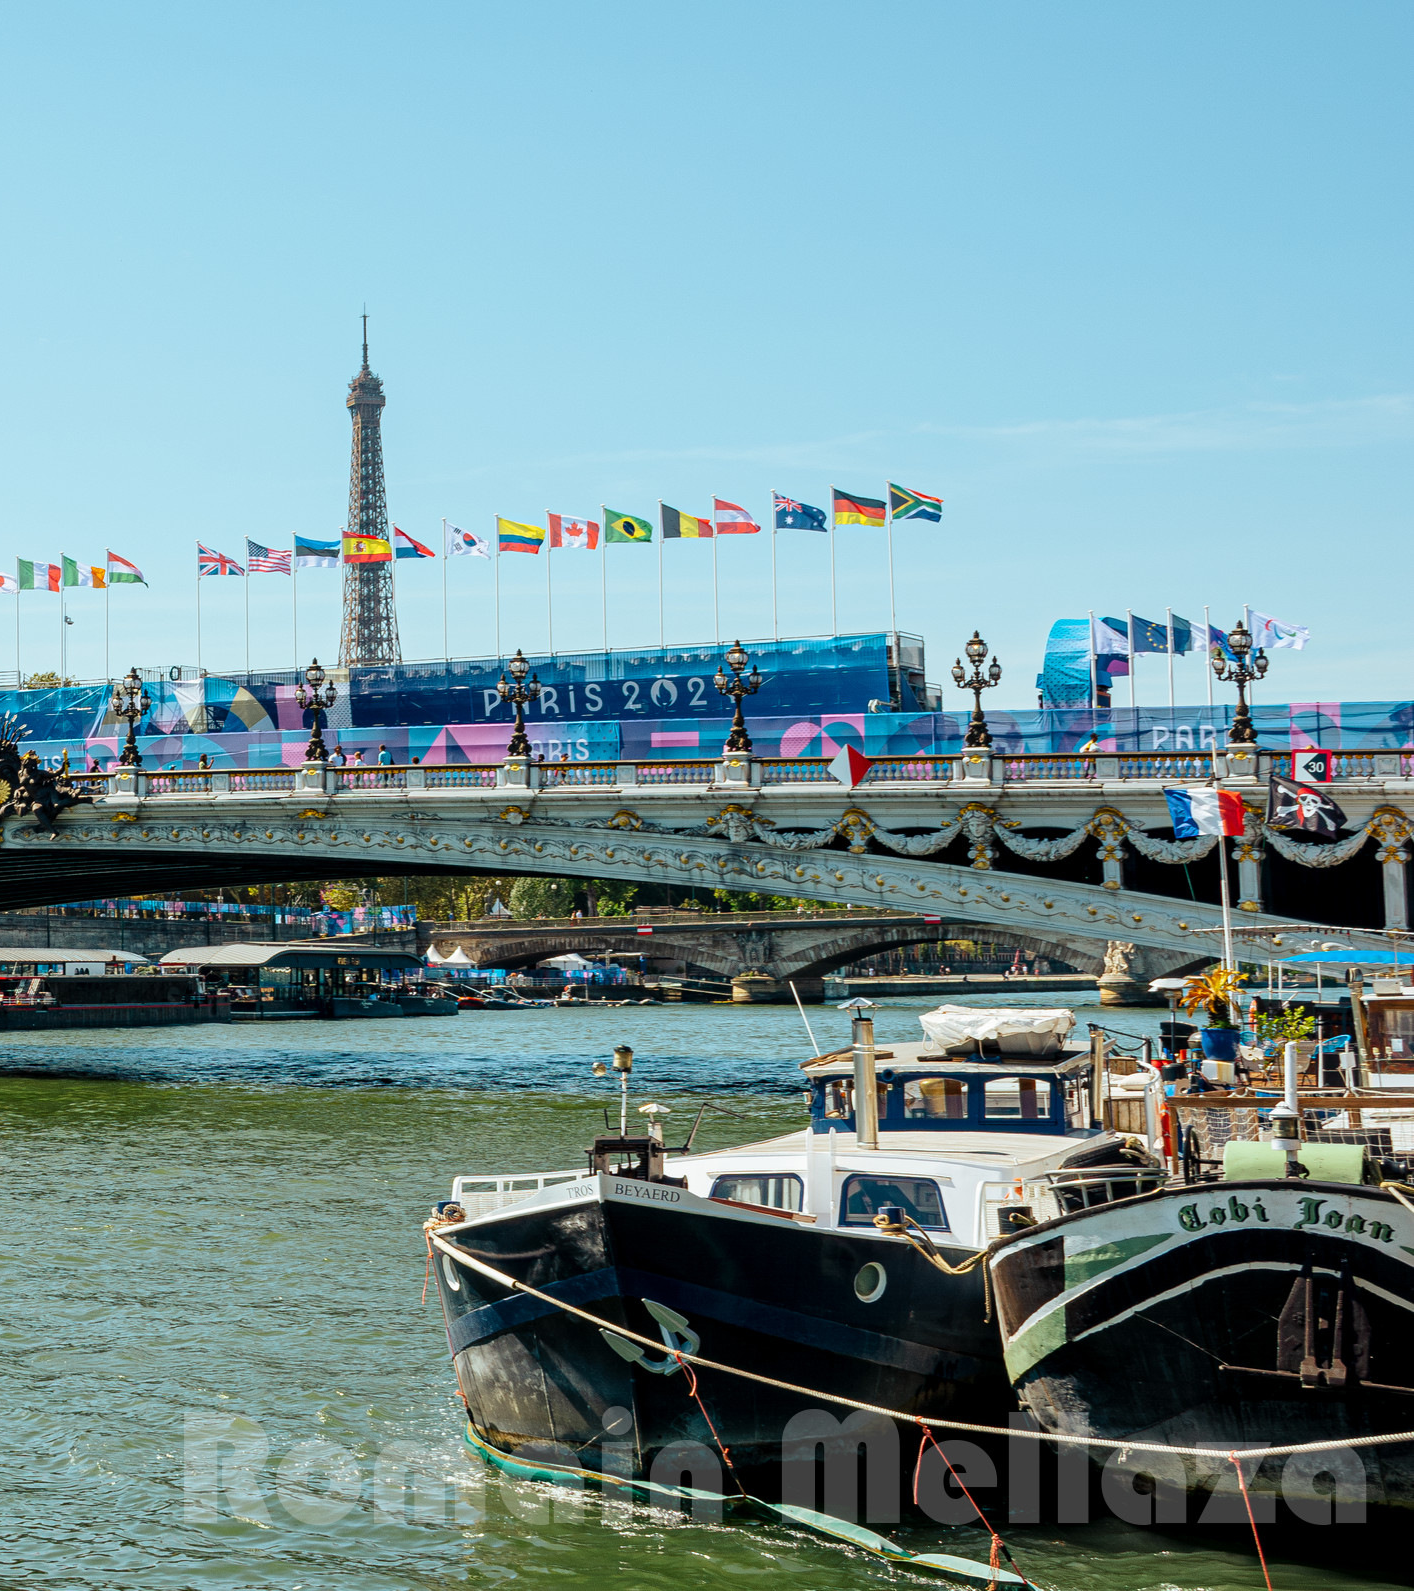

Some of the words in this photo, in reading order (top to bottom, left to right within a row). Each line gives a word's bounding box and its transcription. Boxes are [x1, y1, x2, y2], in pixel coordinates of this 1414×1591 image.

[622, 677, 736, 710] 202
[1308, 761, 1325, 773] 30
[566, 1184, 594, 1199] TROS
[615, 1184, 680, 1203] BEYAERD
[1178, 1196, 1270, 1232] Cobi
